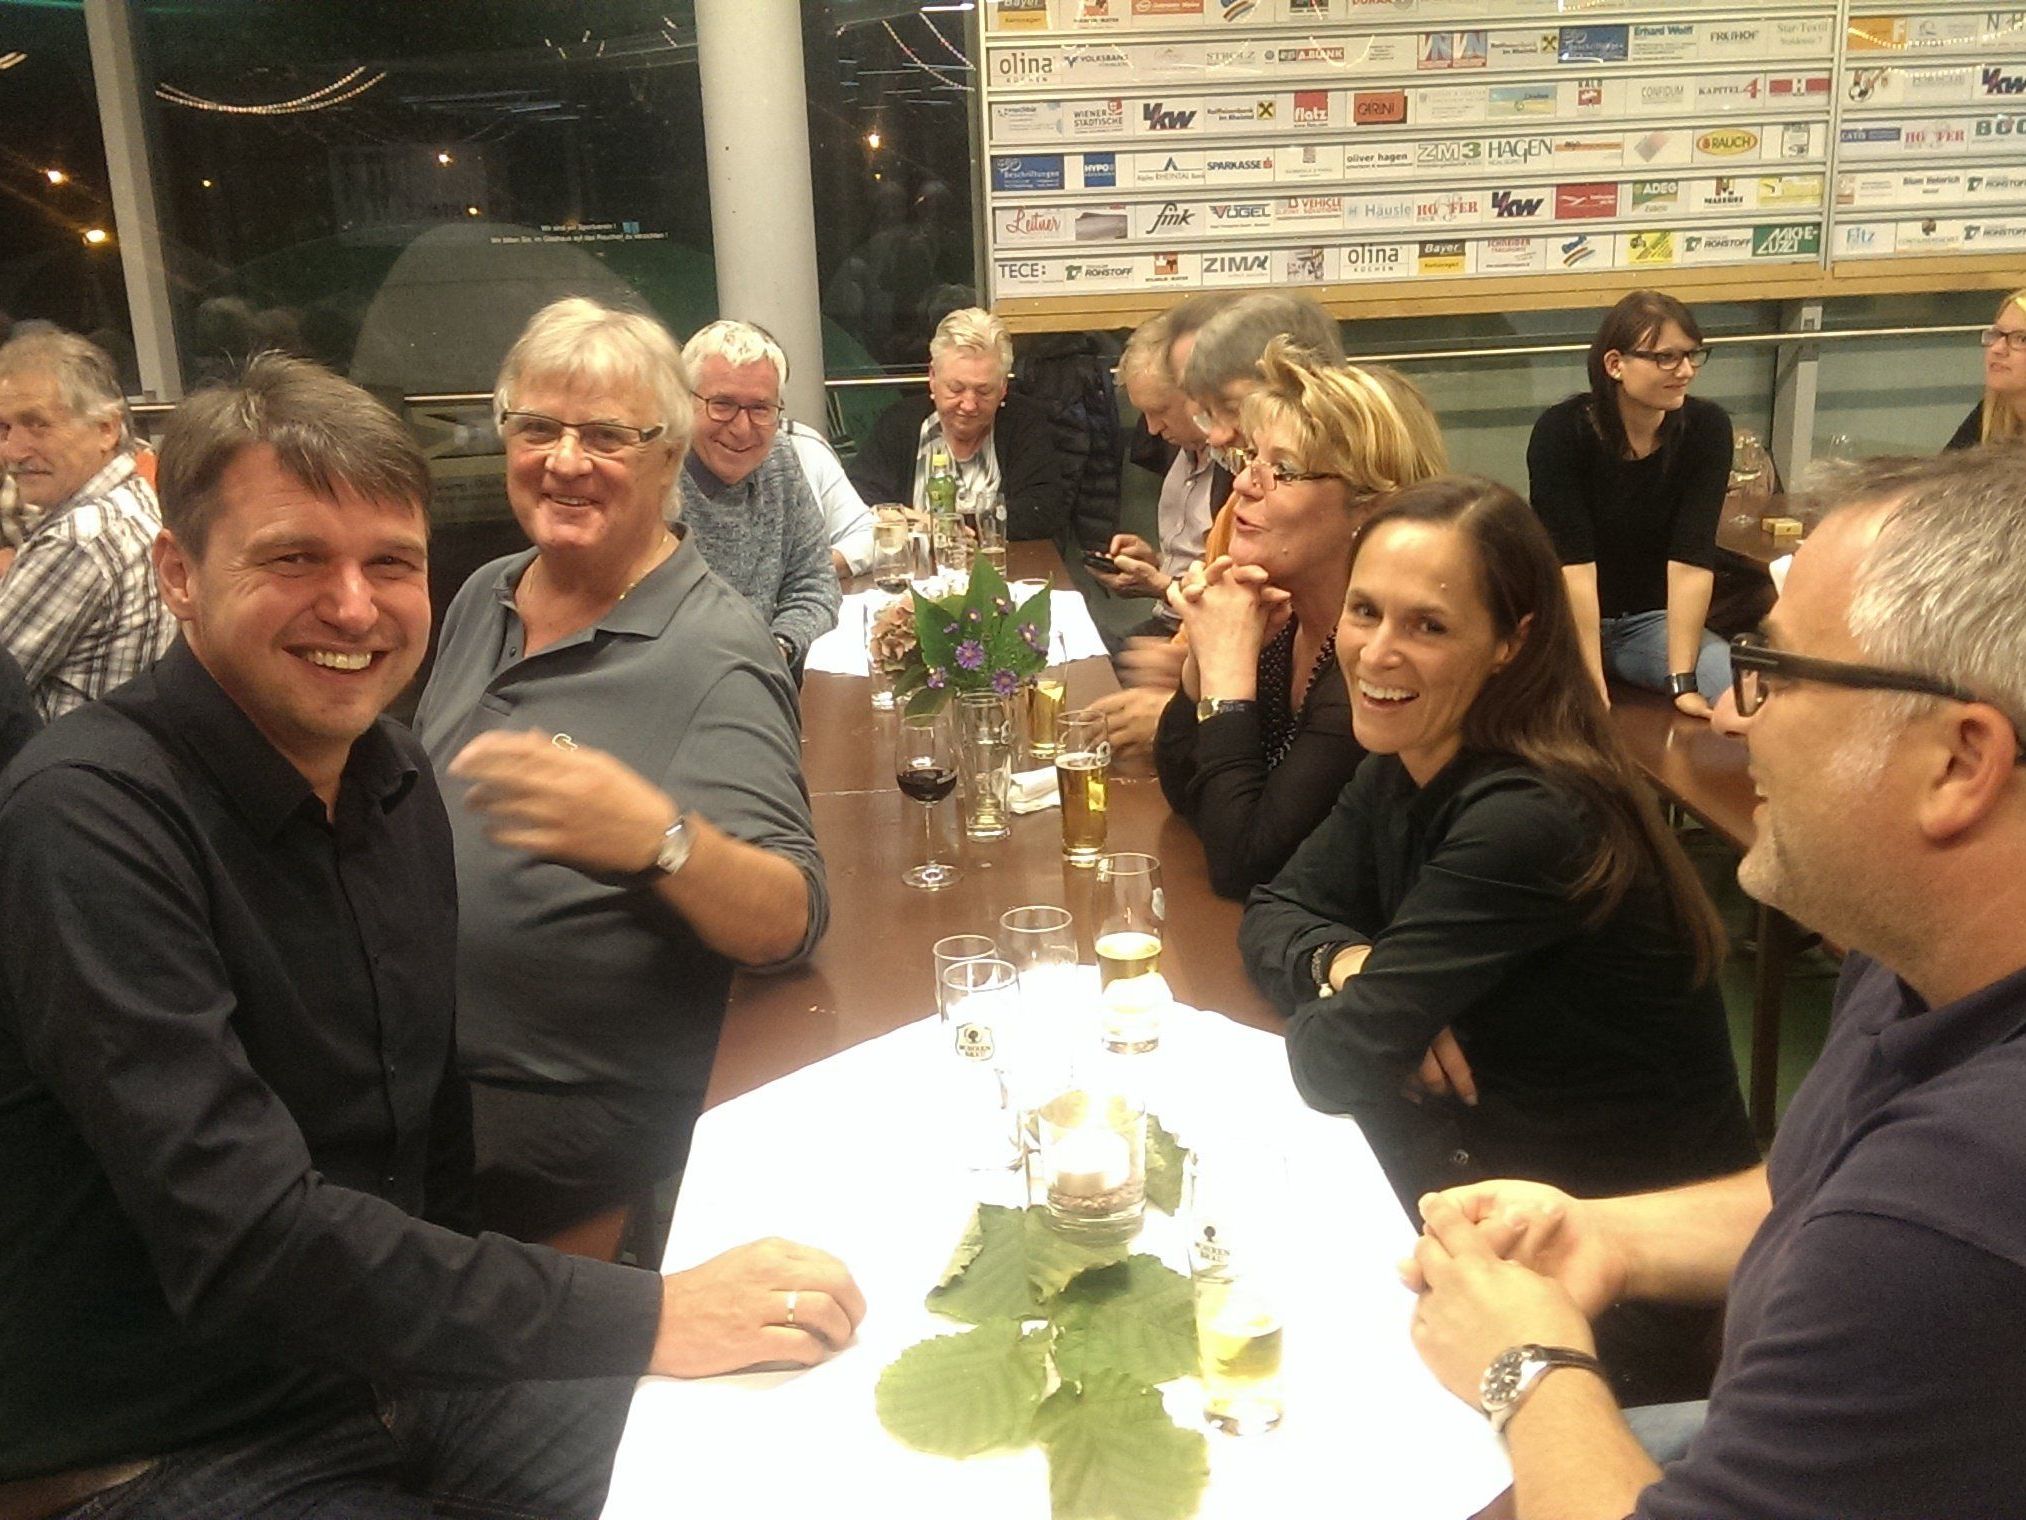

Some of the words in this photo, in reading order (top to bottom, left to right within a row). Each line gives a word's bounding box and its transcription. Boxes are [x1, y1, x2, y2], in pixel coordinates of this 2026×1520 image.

[999, 52, 1052, 75] olina
[1074, 109, 1106, 119] WIENER
[1711, 136, 1751, 149] RAUCH
[1347, 153, 1374, 163] oliver
[1377, 152, 1408, 163] hagen
[1488, 138, 1553, 164] HAGEN
[1207, 159, 1262, 170] SPARKASSE
[1643, 181, 1679, 194] ADEG
[1146, 203, 1195, 234] fink
[1424, 242, 1460, 255] Bayer
[1704, 238, 1751, 249] ROHSTOFF
[1348, 244, 1399, 264] olina
[1085, 267, 1134, 277] ROHSTOFF
